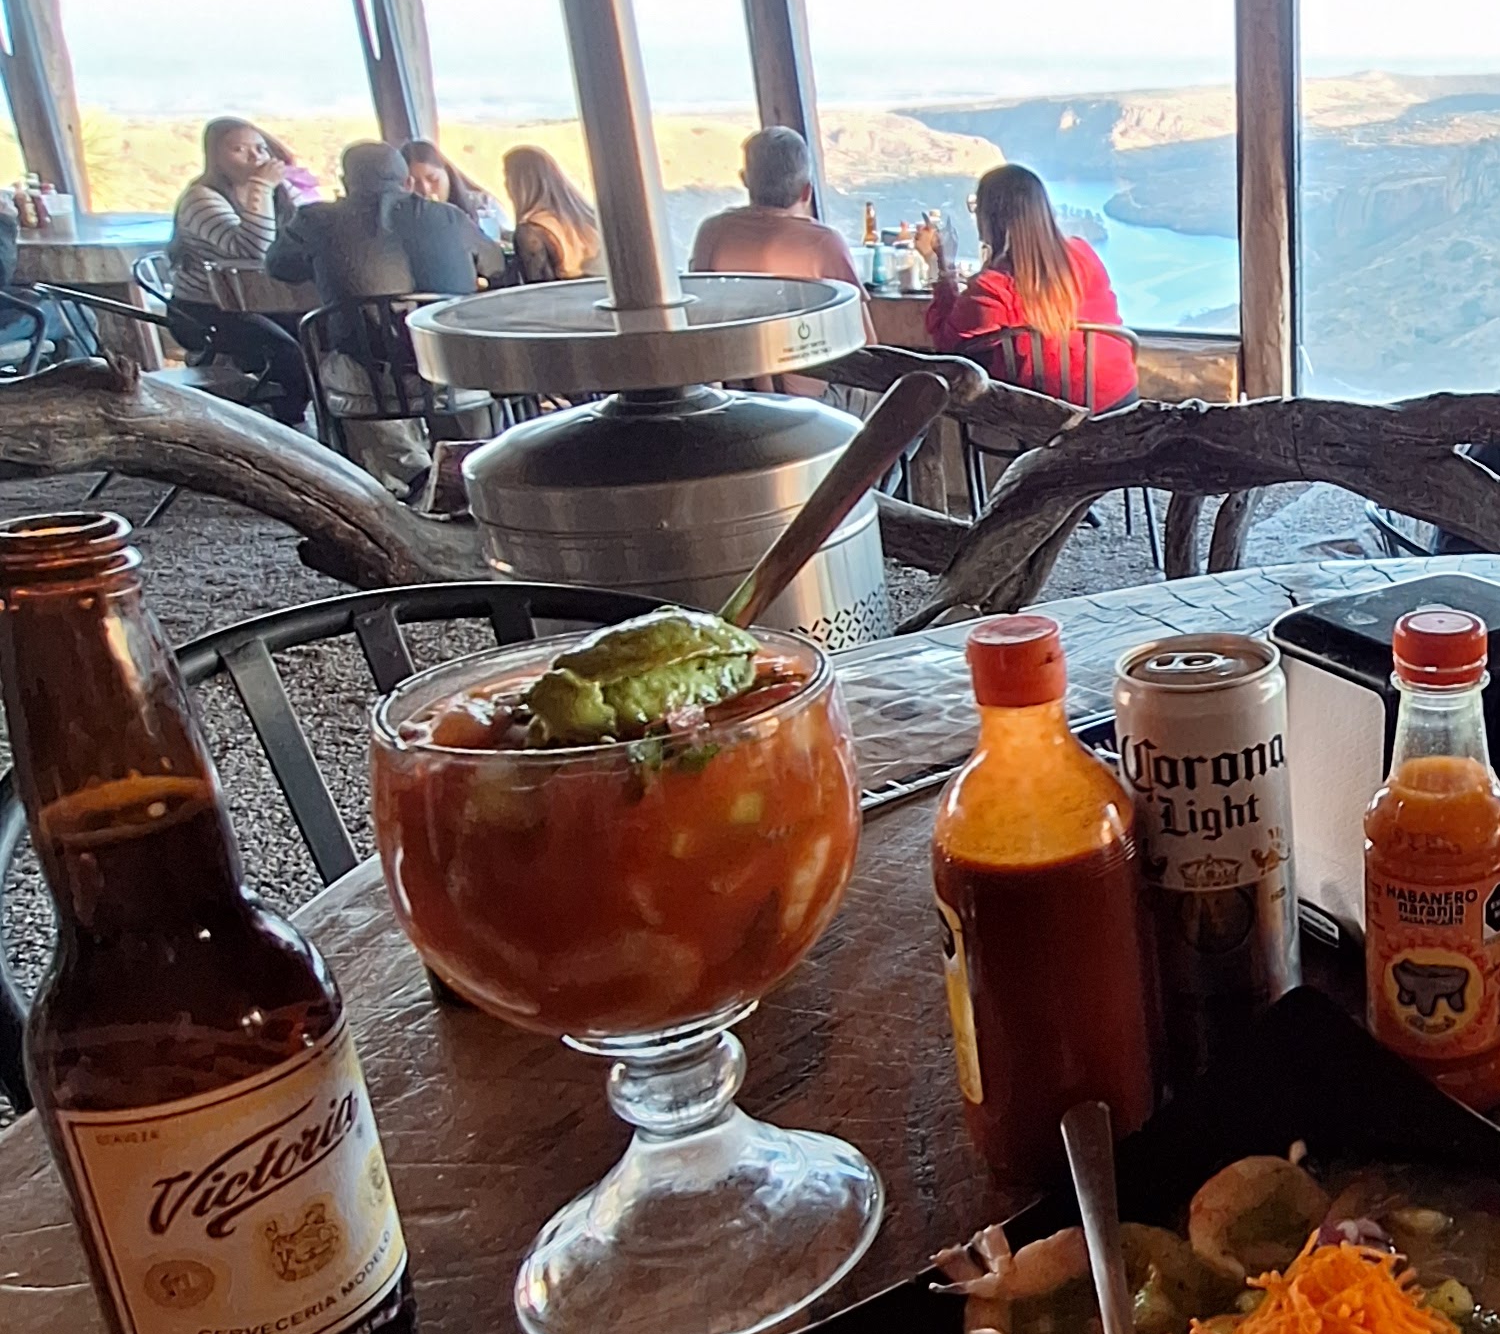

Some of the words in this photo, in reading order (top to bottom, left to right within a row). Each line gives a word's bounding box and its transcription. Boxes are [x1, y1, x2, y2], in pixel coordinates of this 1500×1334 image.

[1121, 733, 1285, 793] Corona
[1157, 794, 1261, 841] Light
[1386, 883, 1479, 906] HABANERO
[1398, 901, 1465, 924] naranja
[150, 1089, 358, 1239] Victoria
[341, 1229, 391, 1297] MODELO
